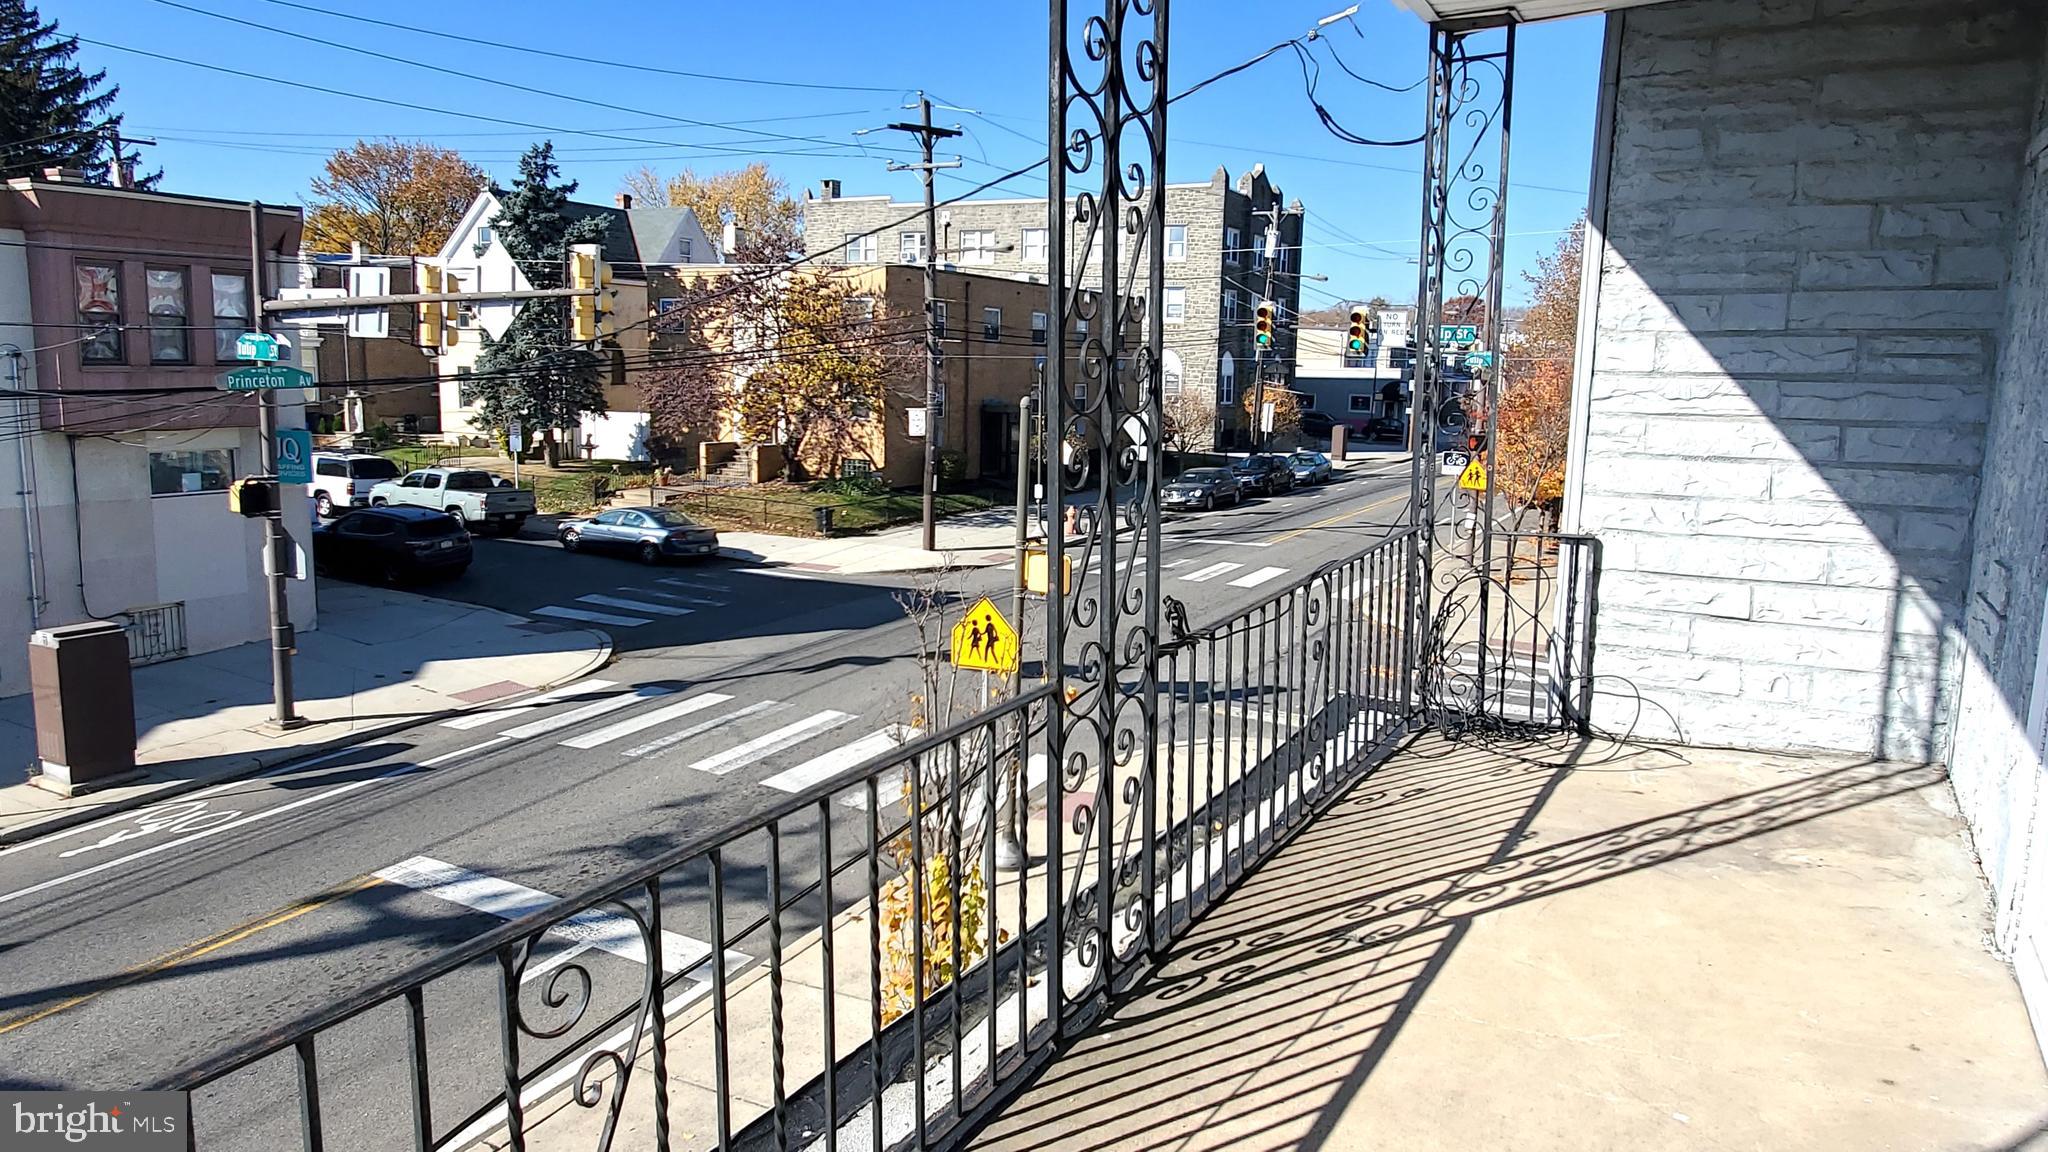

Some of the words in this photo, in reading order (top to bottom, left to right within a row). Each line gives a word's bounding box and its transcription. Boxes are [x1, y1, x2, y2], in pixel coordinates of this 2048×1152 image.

[1456, 329, 1468, 339] St
[237, 341, 257, 358] Tulip
[269, 344, 278, 357] St
[228, 375, 286, 389] Princeton
[300, 375, 312, 387] Av
